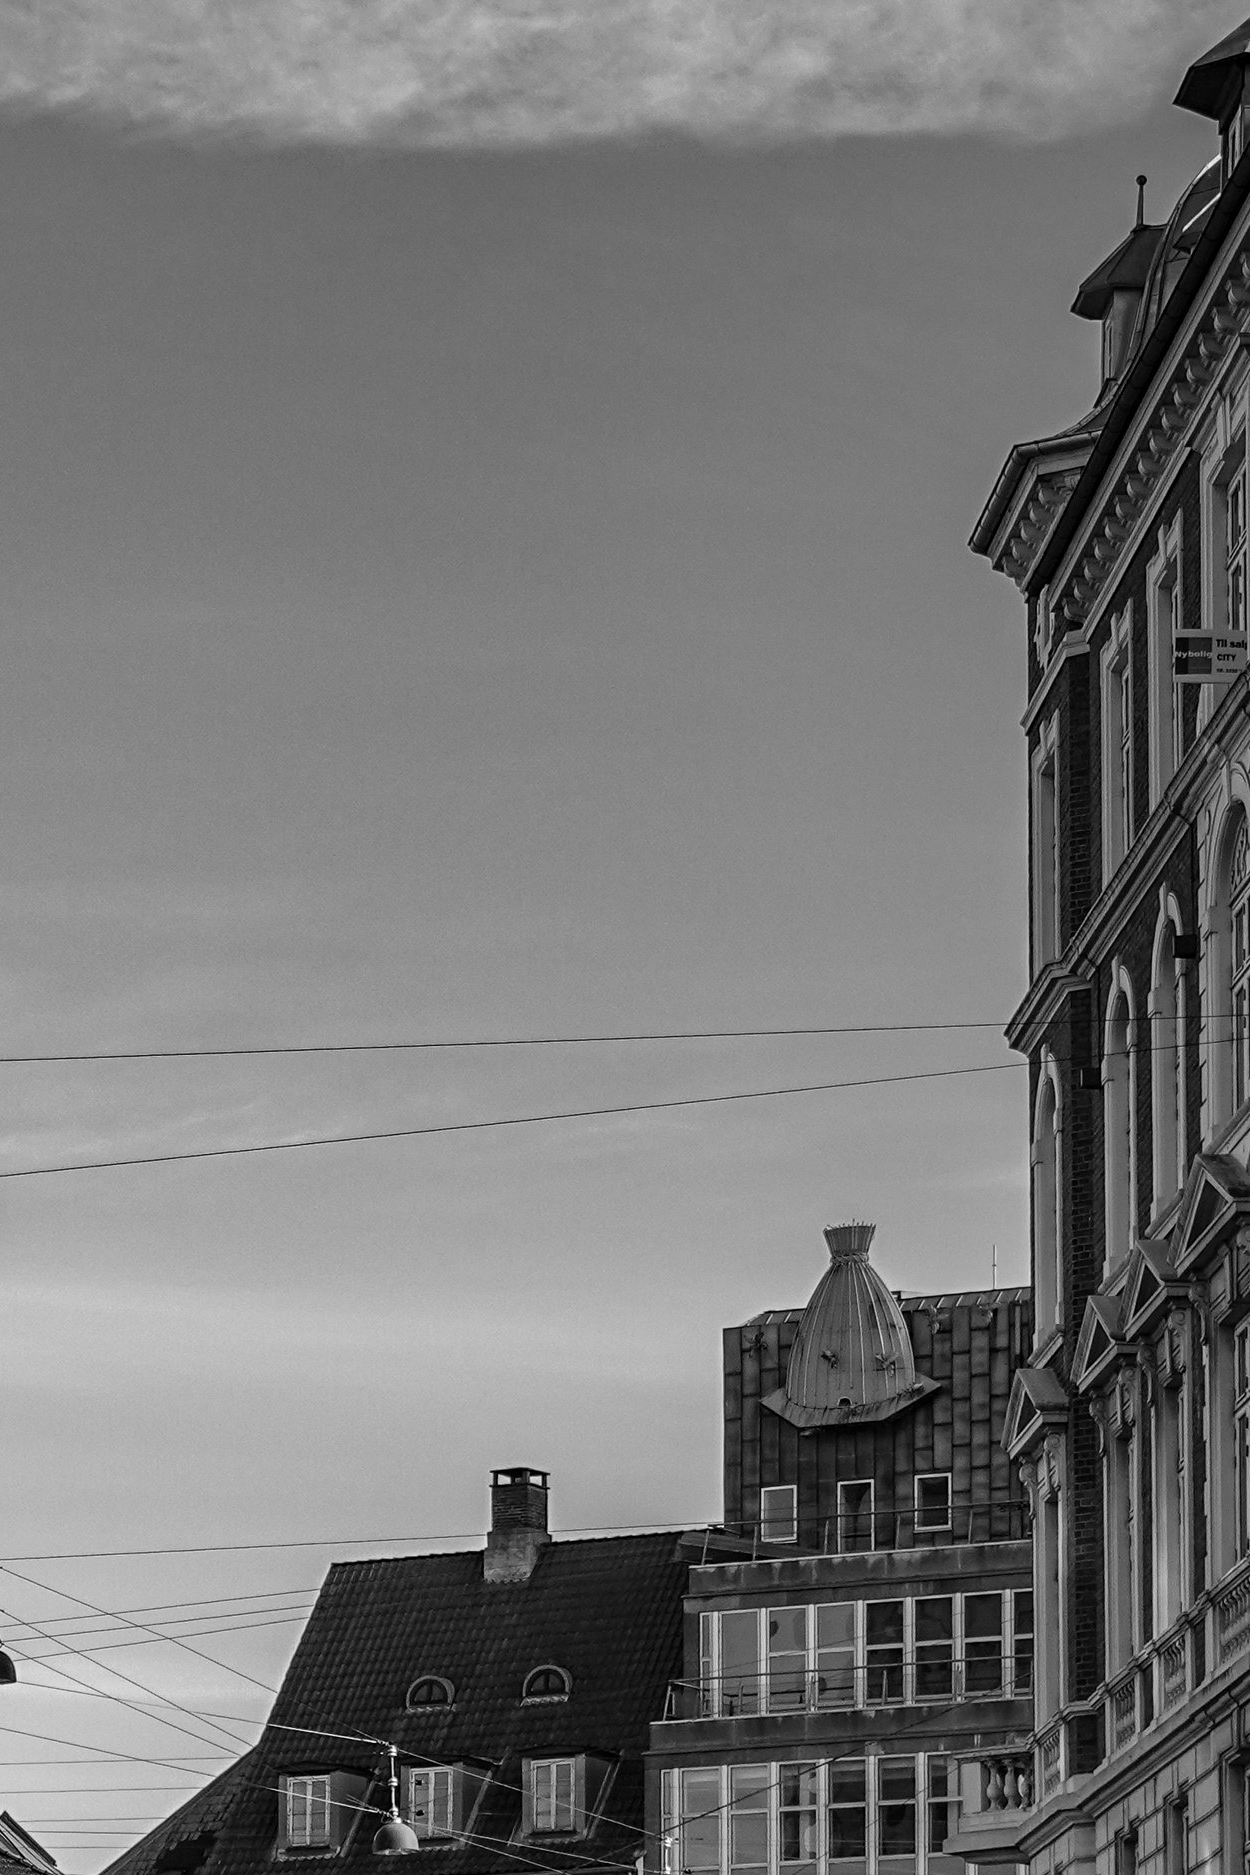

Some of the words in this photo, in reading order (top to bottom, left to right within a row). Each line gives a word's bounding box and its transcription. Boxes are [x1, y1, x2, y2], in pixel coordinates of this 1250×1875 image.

[1216, 639, 1227, 648] Til
[1174, 650, 1213, 660] Nybolig
[1217, 653, 1236, 661] CITY
